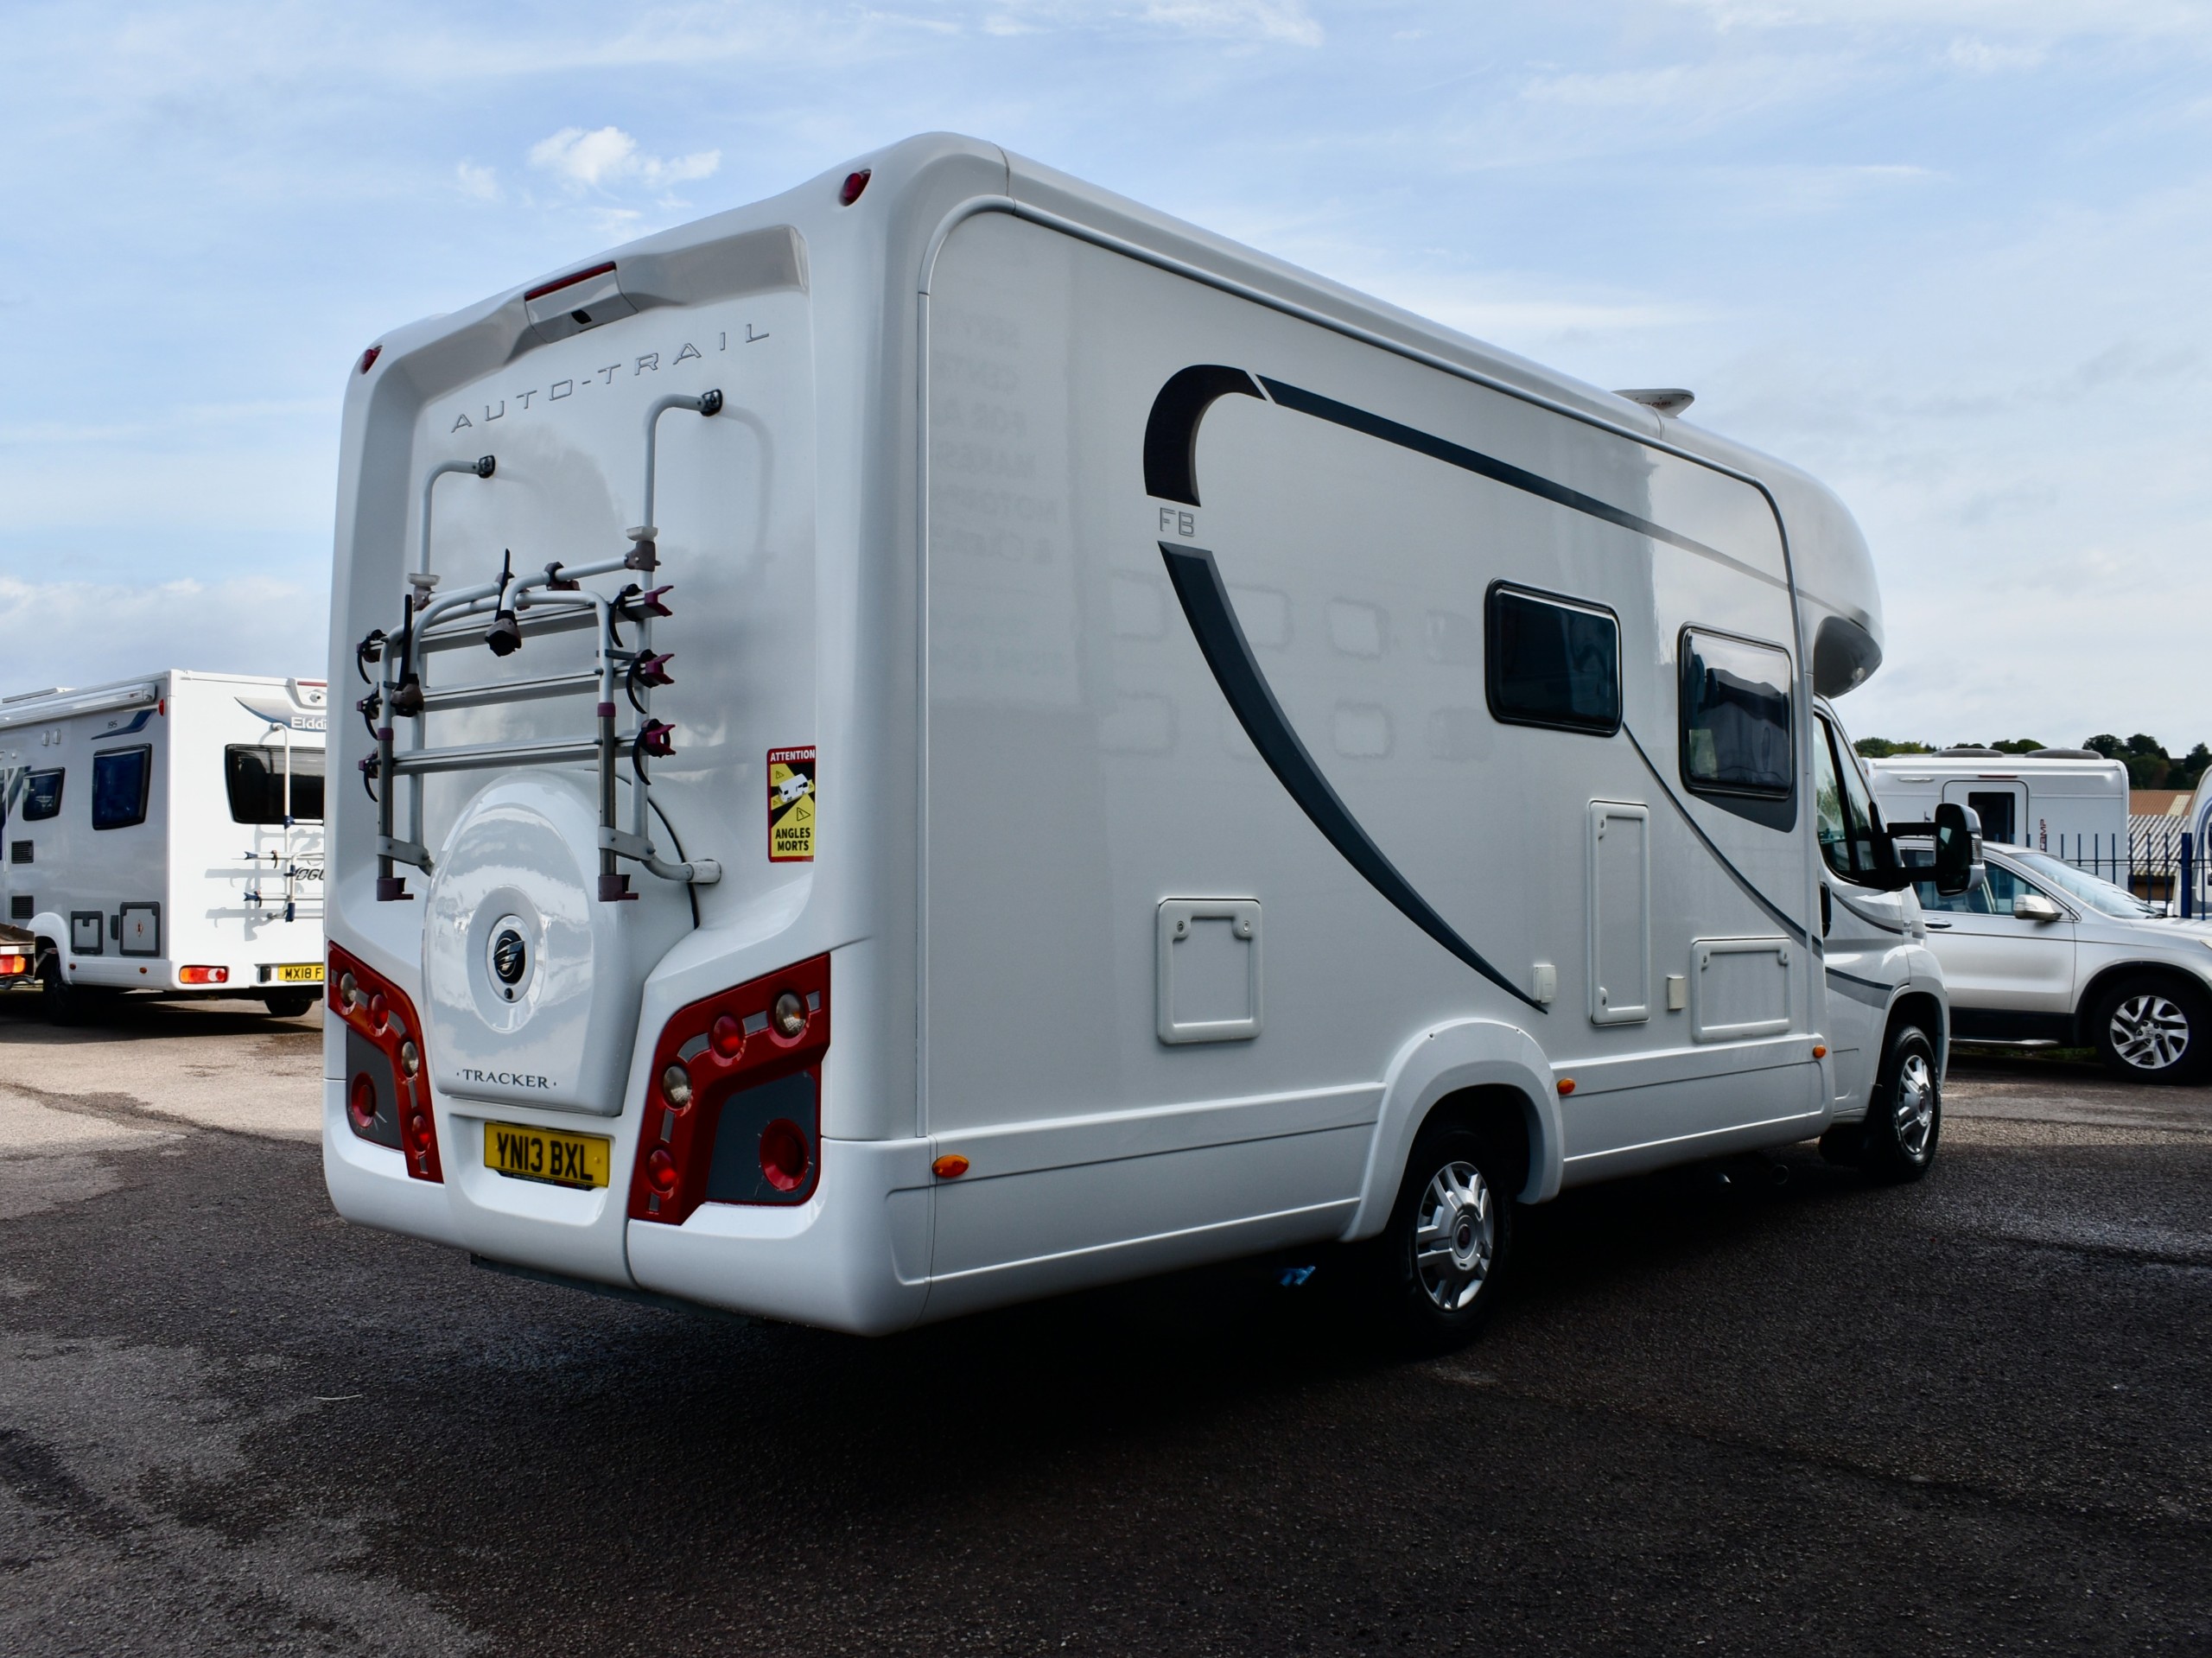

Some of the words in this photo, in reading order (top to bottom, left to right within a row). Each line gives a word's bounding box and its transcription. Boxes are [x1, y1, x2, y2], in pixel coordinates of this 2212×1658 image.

[450, 323, 770, 434] AUTO-TRAIL
[1160, 506, 1195, 537] FB
[770, 748, 816, 762] ATTENTION
[775, 827, 811, 840] ANGLES
[777, 840, 810, 852] MORTS
[285, 967, 312, 980] MX18
[462, 1068, 550, 1089] TRACKER
[496, 1131, 543, 1173] YN13
[550, 1140, 594, 1182] BXL
